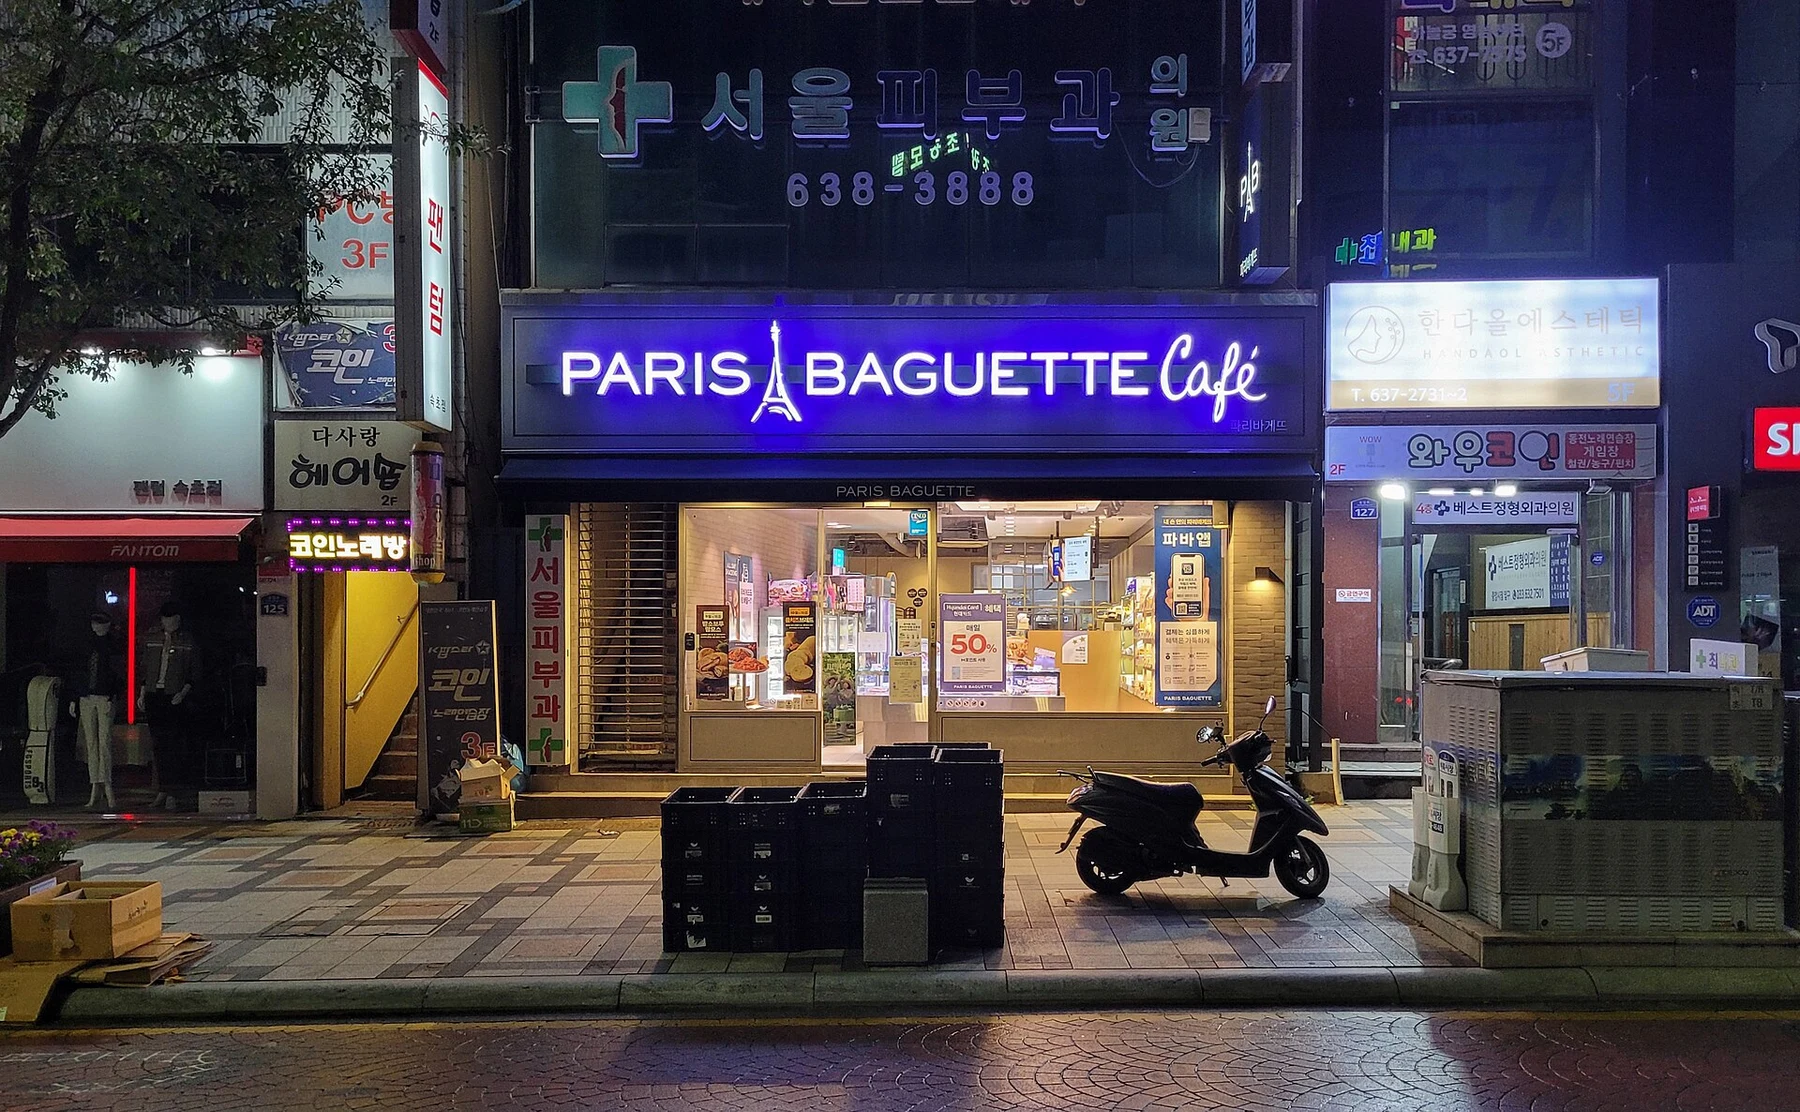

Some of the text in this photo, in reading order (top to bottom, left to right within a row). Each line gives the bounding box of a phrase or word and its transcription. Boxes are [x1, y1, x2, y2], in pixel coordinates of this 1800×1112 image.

[1541, 29, 1566, 54] 5F
[701, 67, 1120, 140] 서울피부과
[786, 170, 1035, 207] 638-3888
[341, 239, 390, 269] 3F
[1418, 305, 1643, 337] 한다올에스테틱
[306, 348, 375, 384] 코인
[561, 332, 1267, 422] PARIS BAGUETTE Café
[1351, 386, 1468, 402] T. 637-2731~2
[1607, 382, 1635, 402] 5F
[1230, 419, 1288, 432] 파리바게뜨
[312, 426, 381, 448] 다사랑
[1568, 433, 1634, 445] 동전노래연습장
[1407, 429, 1561, 474] 와우코인
[1583, 445, 1619, 458] 게임장
[1329, 463, 1347, 475] 2F
[381, 495, 398, 506] 2F
[836, 485, 976, 497] PARIS BAGUETTE
[1354, 508, 1375, 517] 127
[1415, 501, 1574, 516] 4층 베스트정형외과의원
[289, 533, 407, 560] 코인노래방
[1162, 532, 1211, 548] 파바앱
[110, 545, 180, 557] FANTOM
[263, 604, 286, 614] 125
[1692, 605, 1716, 617] ADT
[530, 556, 562, 723] 서울피부과
[950, 633, 998, 655] 50%
[428, 668, 491, 702] 코인
